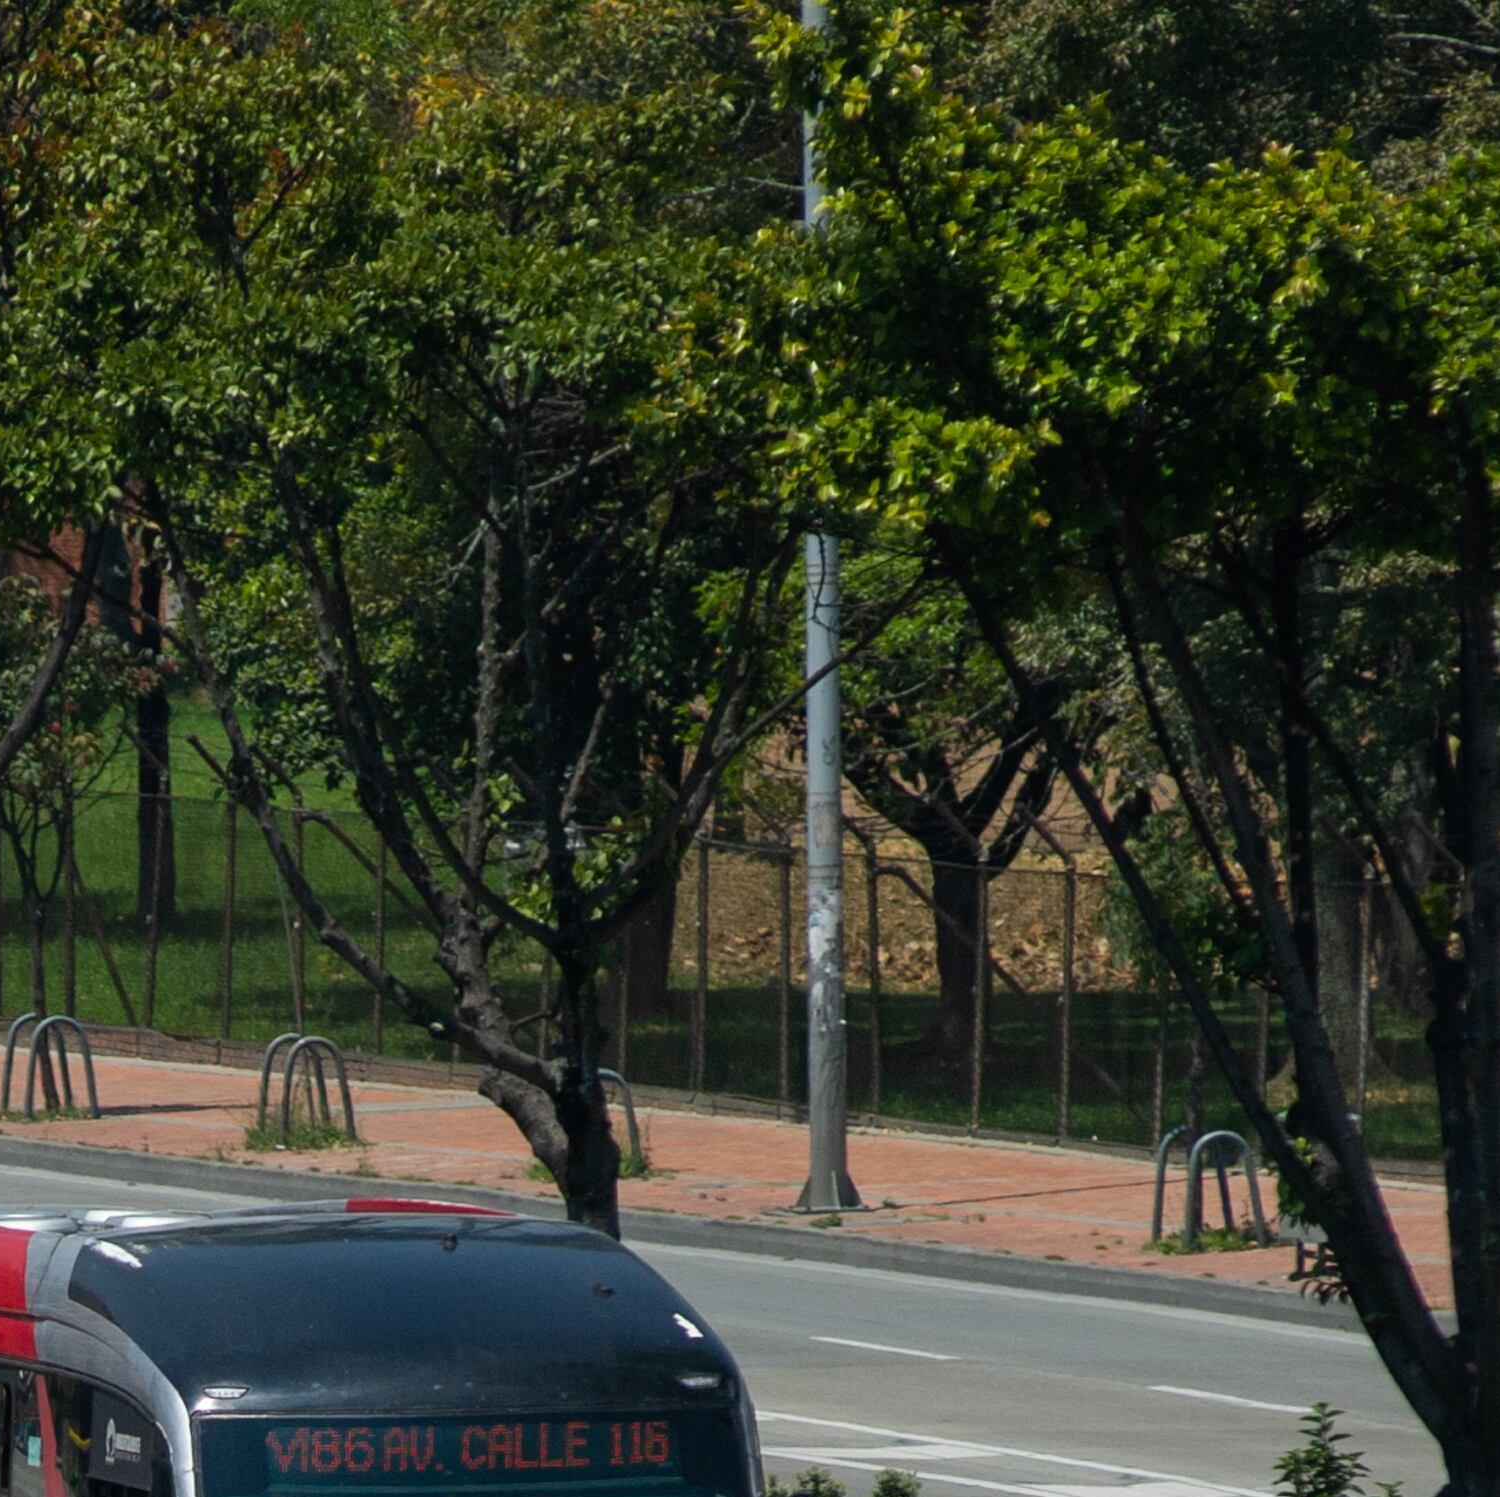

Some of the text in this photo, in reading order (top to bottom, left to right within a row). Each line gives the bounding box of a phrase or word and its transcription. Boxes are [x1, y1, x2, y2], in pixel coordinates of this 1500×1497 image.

[382, 1425, 445, 1472] AV.
[462, 1421, 591, 1470] CALLE
[609, 1420, 670, 1466] 116
